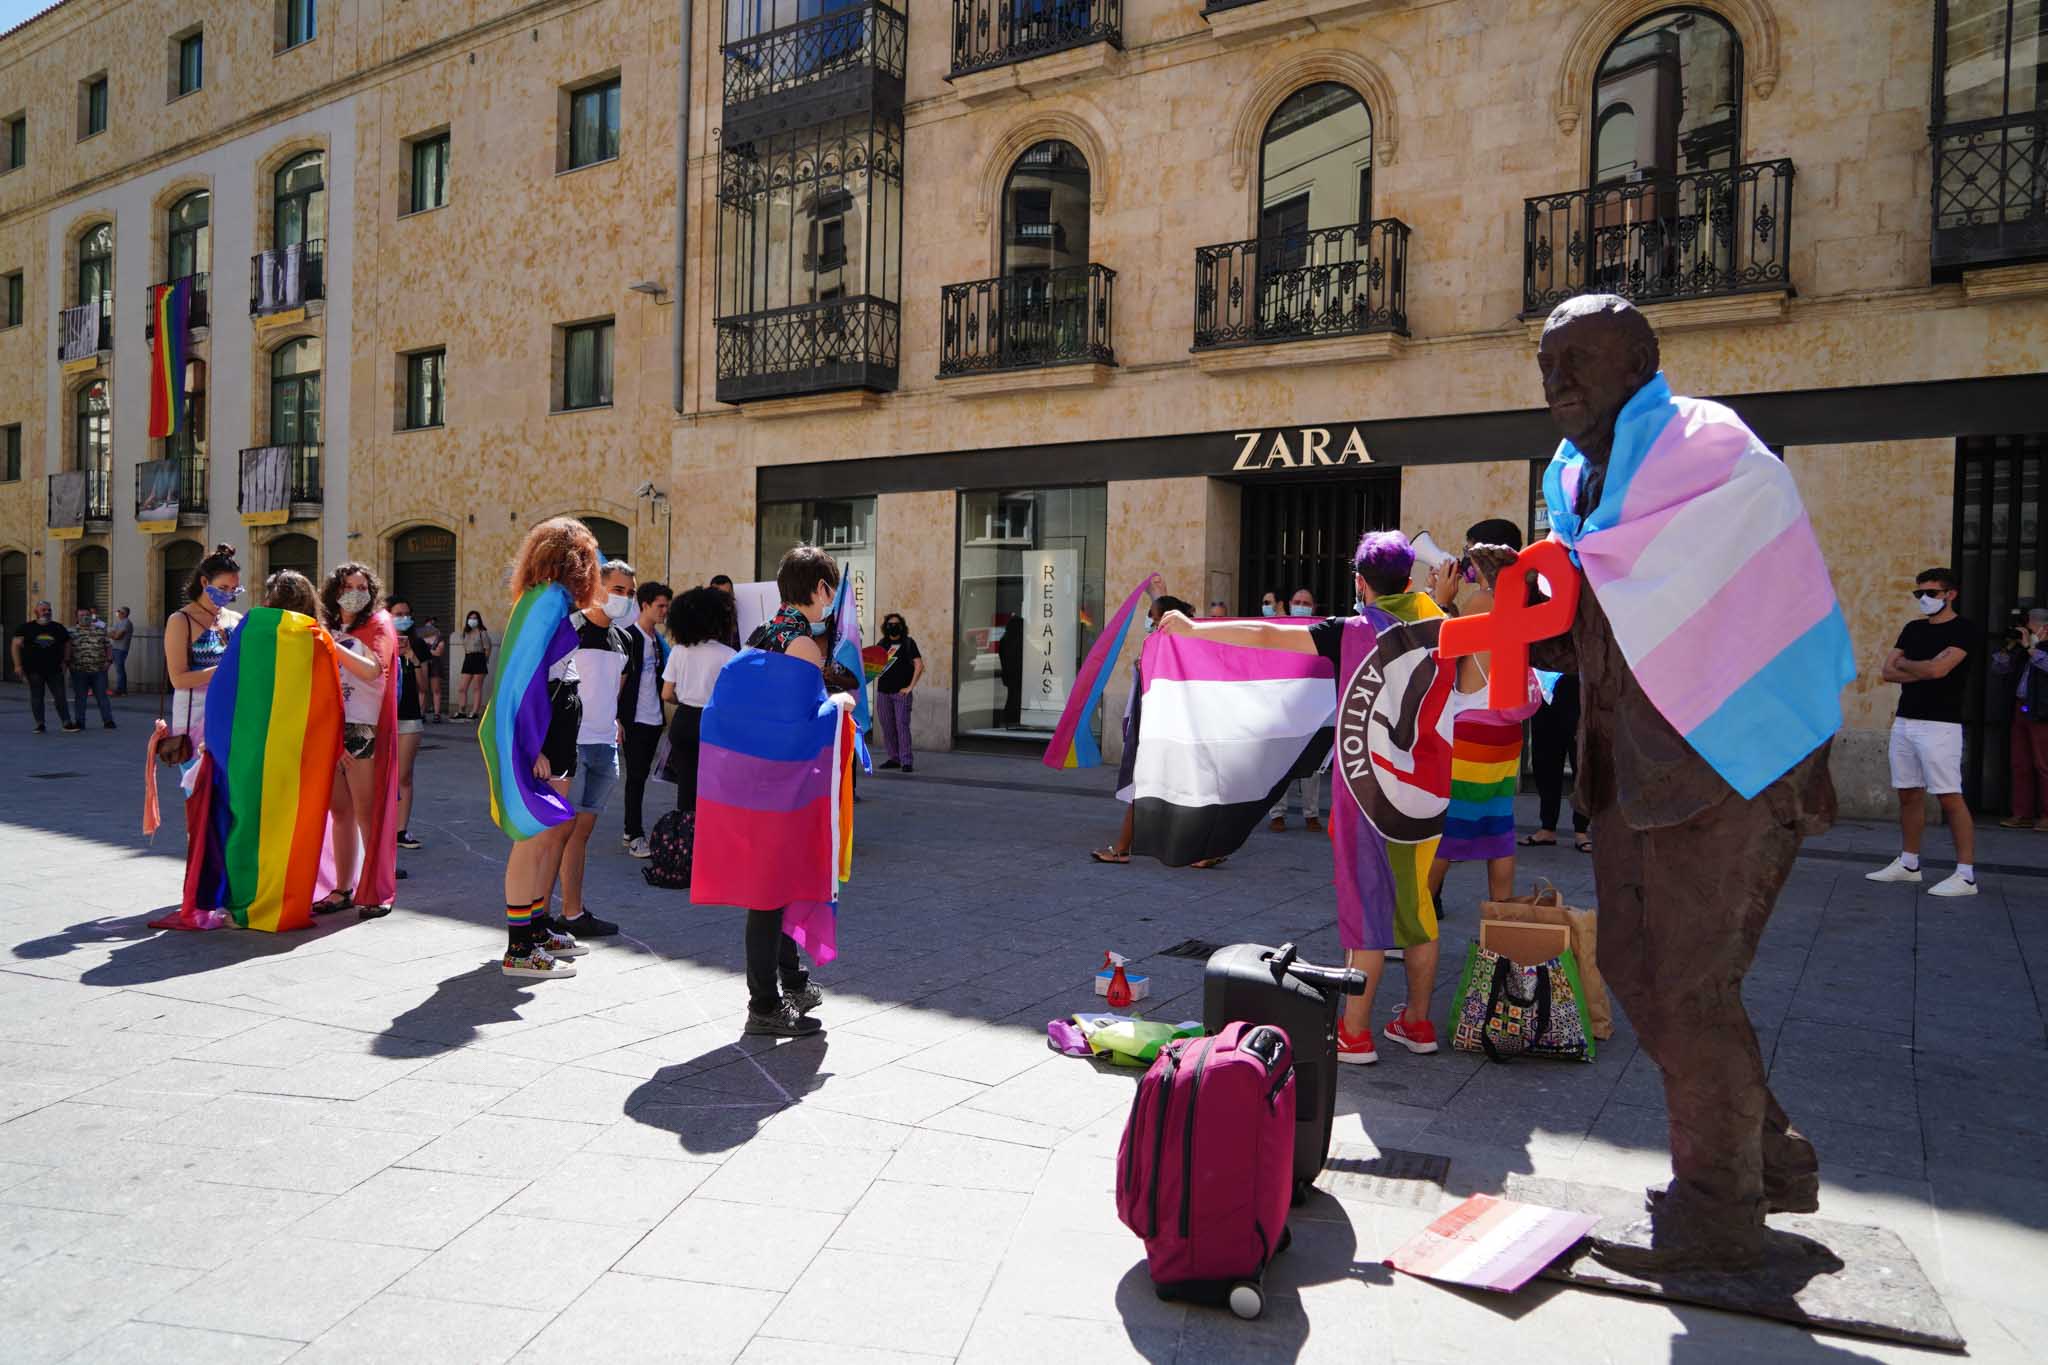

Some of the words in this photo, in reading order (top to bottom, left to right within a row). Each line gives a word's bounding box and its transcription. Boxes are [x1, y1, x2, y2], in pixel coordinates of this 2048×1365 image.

[1233, 426, 1375, 470] ZARA
[1042, 565, 1054, 694] REBAJAS
[1343, 664, 1384, 779] AKTION
